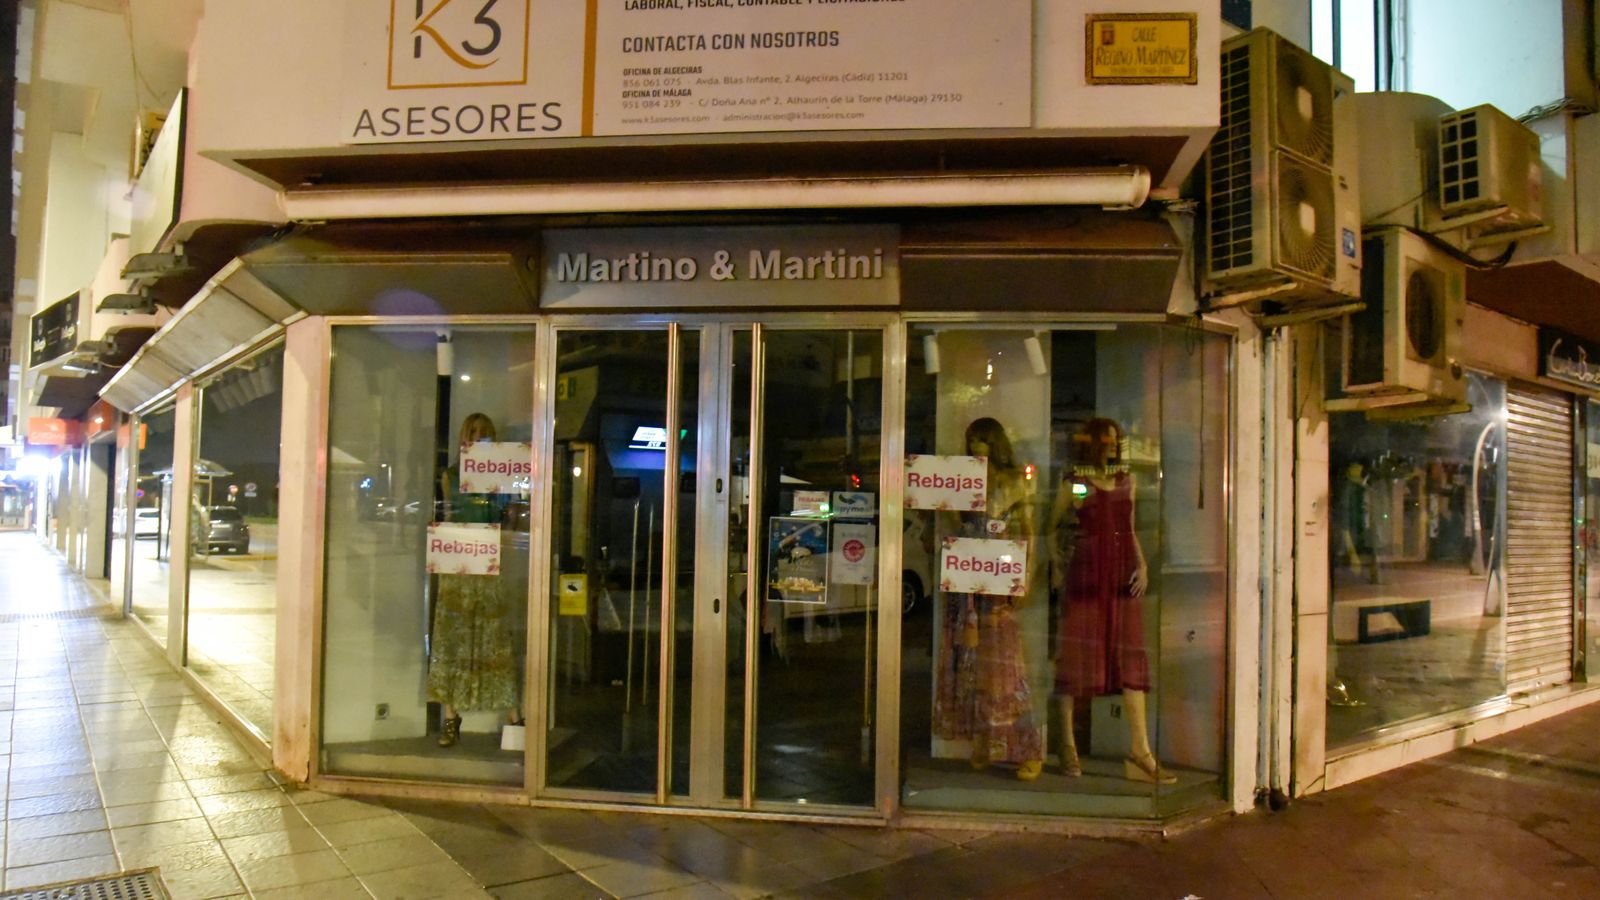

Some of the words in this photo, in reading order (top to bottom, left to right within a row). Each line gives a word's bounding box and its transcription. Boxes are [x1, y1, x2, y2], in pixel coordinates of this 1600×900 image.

[623, 35, 706, 53] CONTACTA
[712, 34, 745, 50] CON
[750, 31, 839, 48] NOSOTROS
[623, 68, 651, 76] OFICINA
[653, 67, 662, 75] DE
[664, 66, 703, 75] ALGECIRAS
[663, 77, 681, 86] 075
[723, 76, 743, 84] Blas
[746, 75, 782, 84] Infante,
[795, 74, 839, 84] Algeciras
[878, 72, 908, 81] 11201
[622, 90, 650, 98] OFICINA
[652, 89, 661, 97] DE
[663, 88, 692, 97] MÁLAGA
[712, 97, 736, 106] Doña
[739, 97, 757, 105] Ana
[831, 95, 842, 103] de
[845, 94, 854, 102] la
[858, 94, 882, 103] Torre
[931, 93, 962, 102] 29130
[353, 102, 562, 137] ASESORES
[558, 252, 697, 281] Martino
[710, 250, 737, 281] &
[750, 249, 882, 279] Martini
[464, 459, 532, 476] Rebajas
[907, 472, 984, 492] Rebajas
[431, 539, 498, 557] Rebajas
[946, 555, 1023, 577] Rebajas
